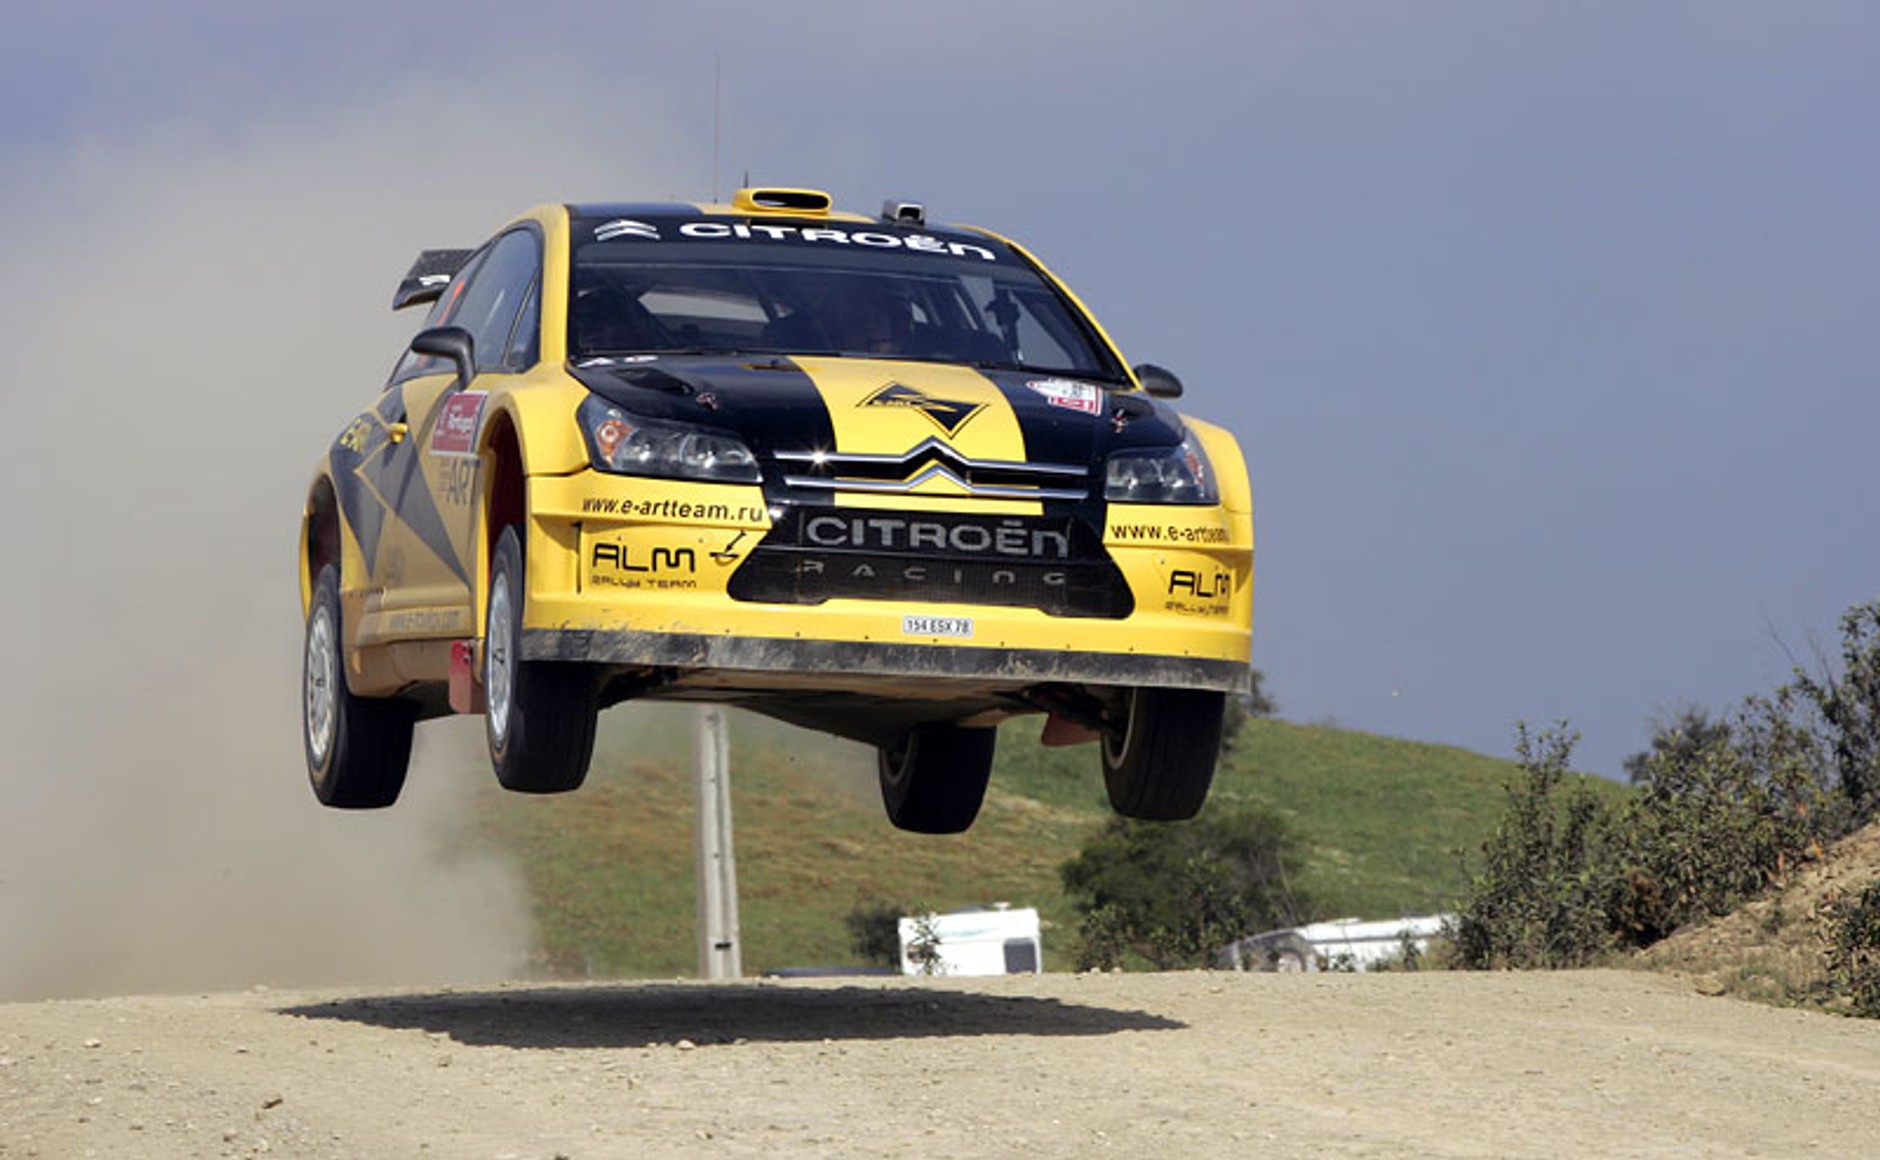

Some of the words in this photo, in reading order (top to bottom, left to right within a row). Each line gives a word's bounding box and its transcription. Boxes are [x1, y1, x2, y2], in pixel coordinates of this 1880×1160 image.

[583, 498, 763, 523] www.e-artteam.ru
[593, 542, 695, 573] ALM
[907, 620, 927, 631] 154
